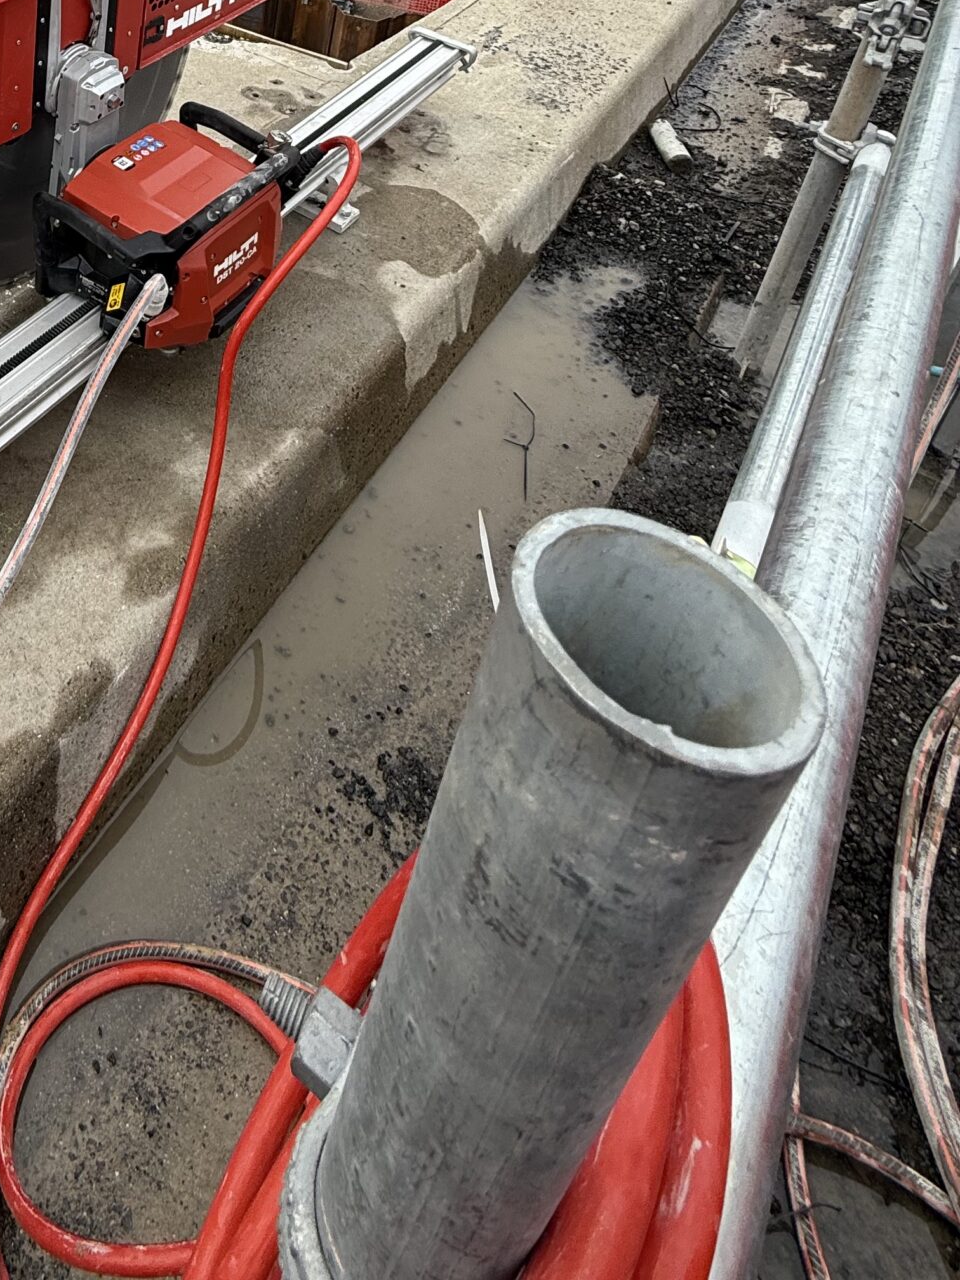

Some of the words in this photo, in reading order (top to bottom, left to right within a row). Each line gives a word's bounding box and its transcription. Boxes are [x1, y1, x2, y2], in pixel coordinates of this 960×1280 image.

[213, 231, 259, 278] HILTI
[216, 265, 234, 285] DST
[234, 245, 258, 271] 20-CA
